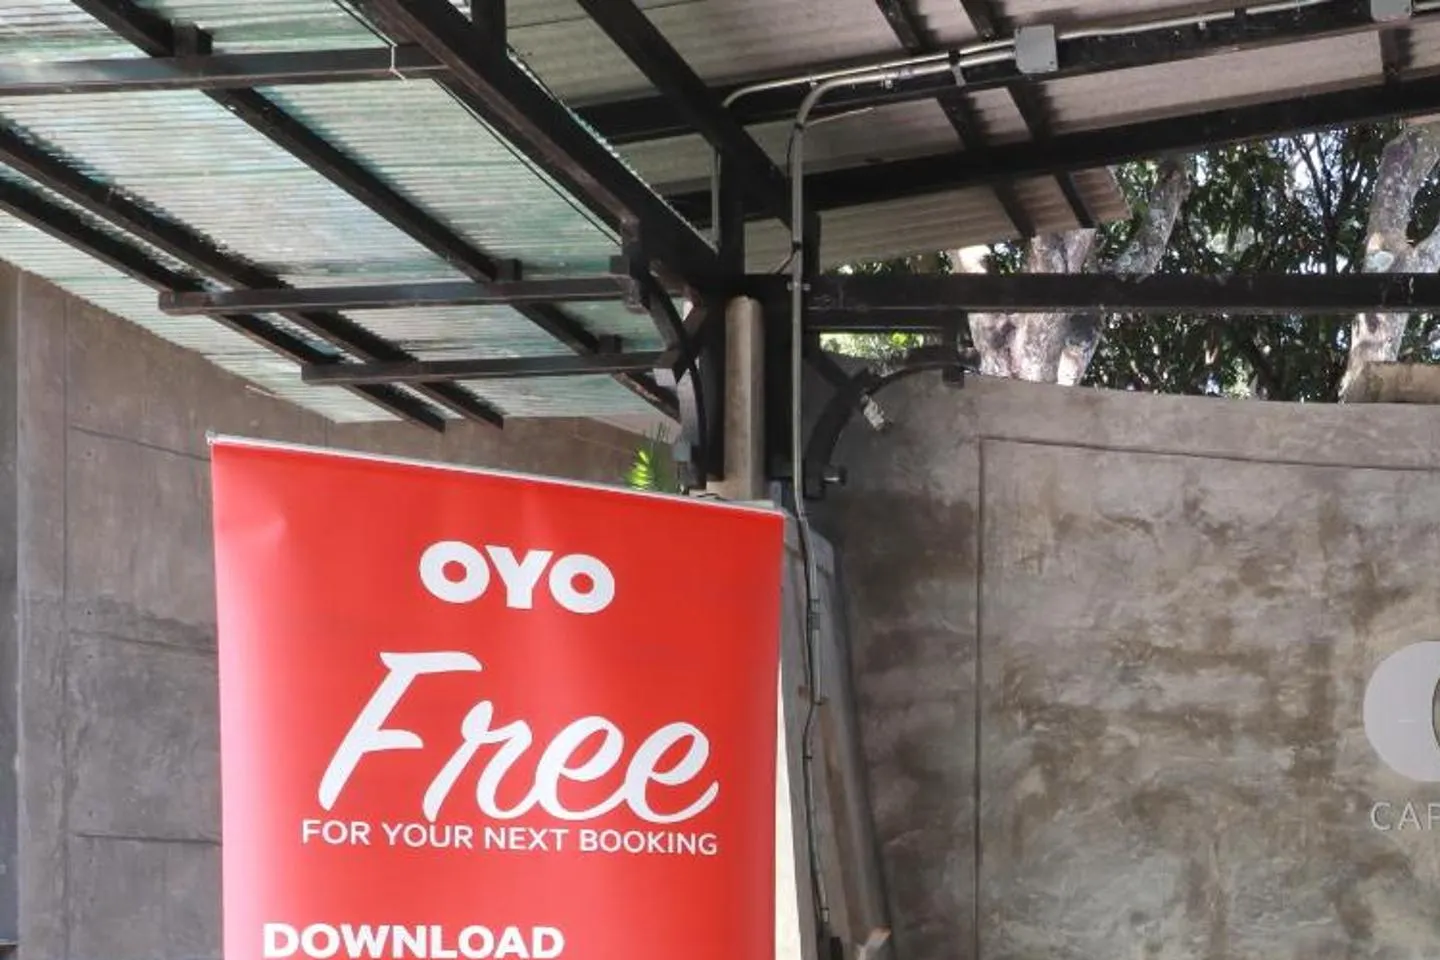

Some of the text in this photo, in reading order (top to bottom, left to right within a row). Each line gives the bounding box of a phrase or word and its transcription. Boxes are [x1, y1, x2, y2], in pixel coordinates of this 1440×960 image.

[419, 541, 615, 613] OYO
[318, 651, 719, 823] Free
[302, 819, 718, 856] FOR YOUR NEXT BOOKING
[263, 922, 565, 960] DOWNLOAD
